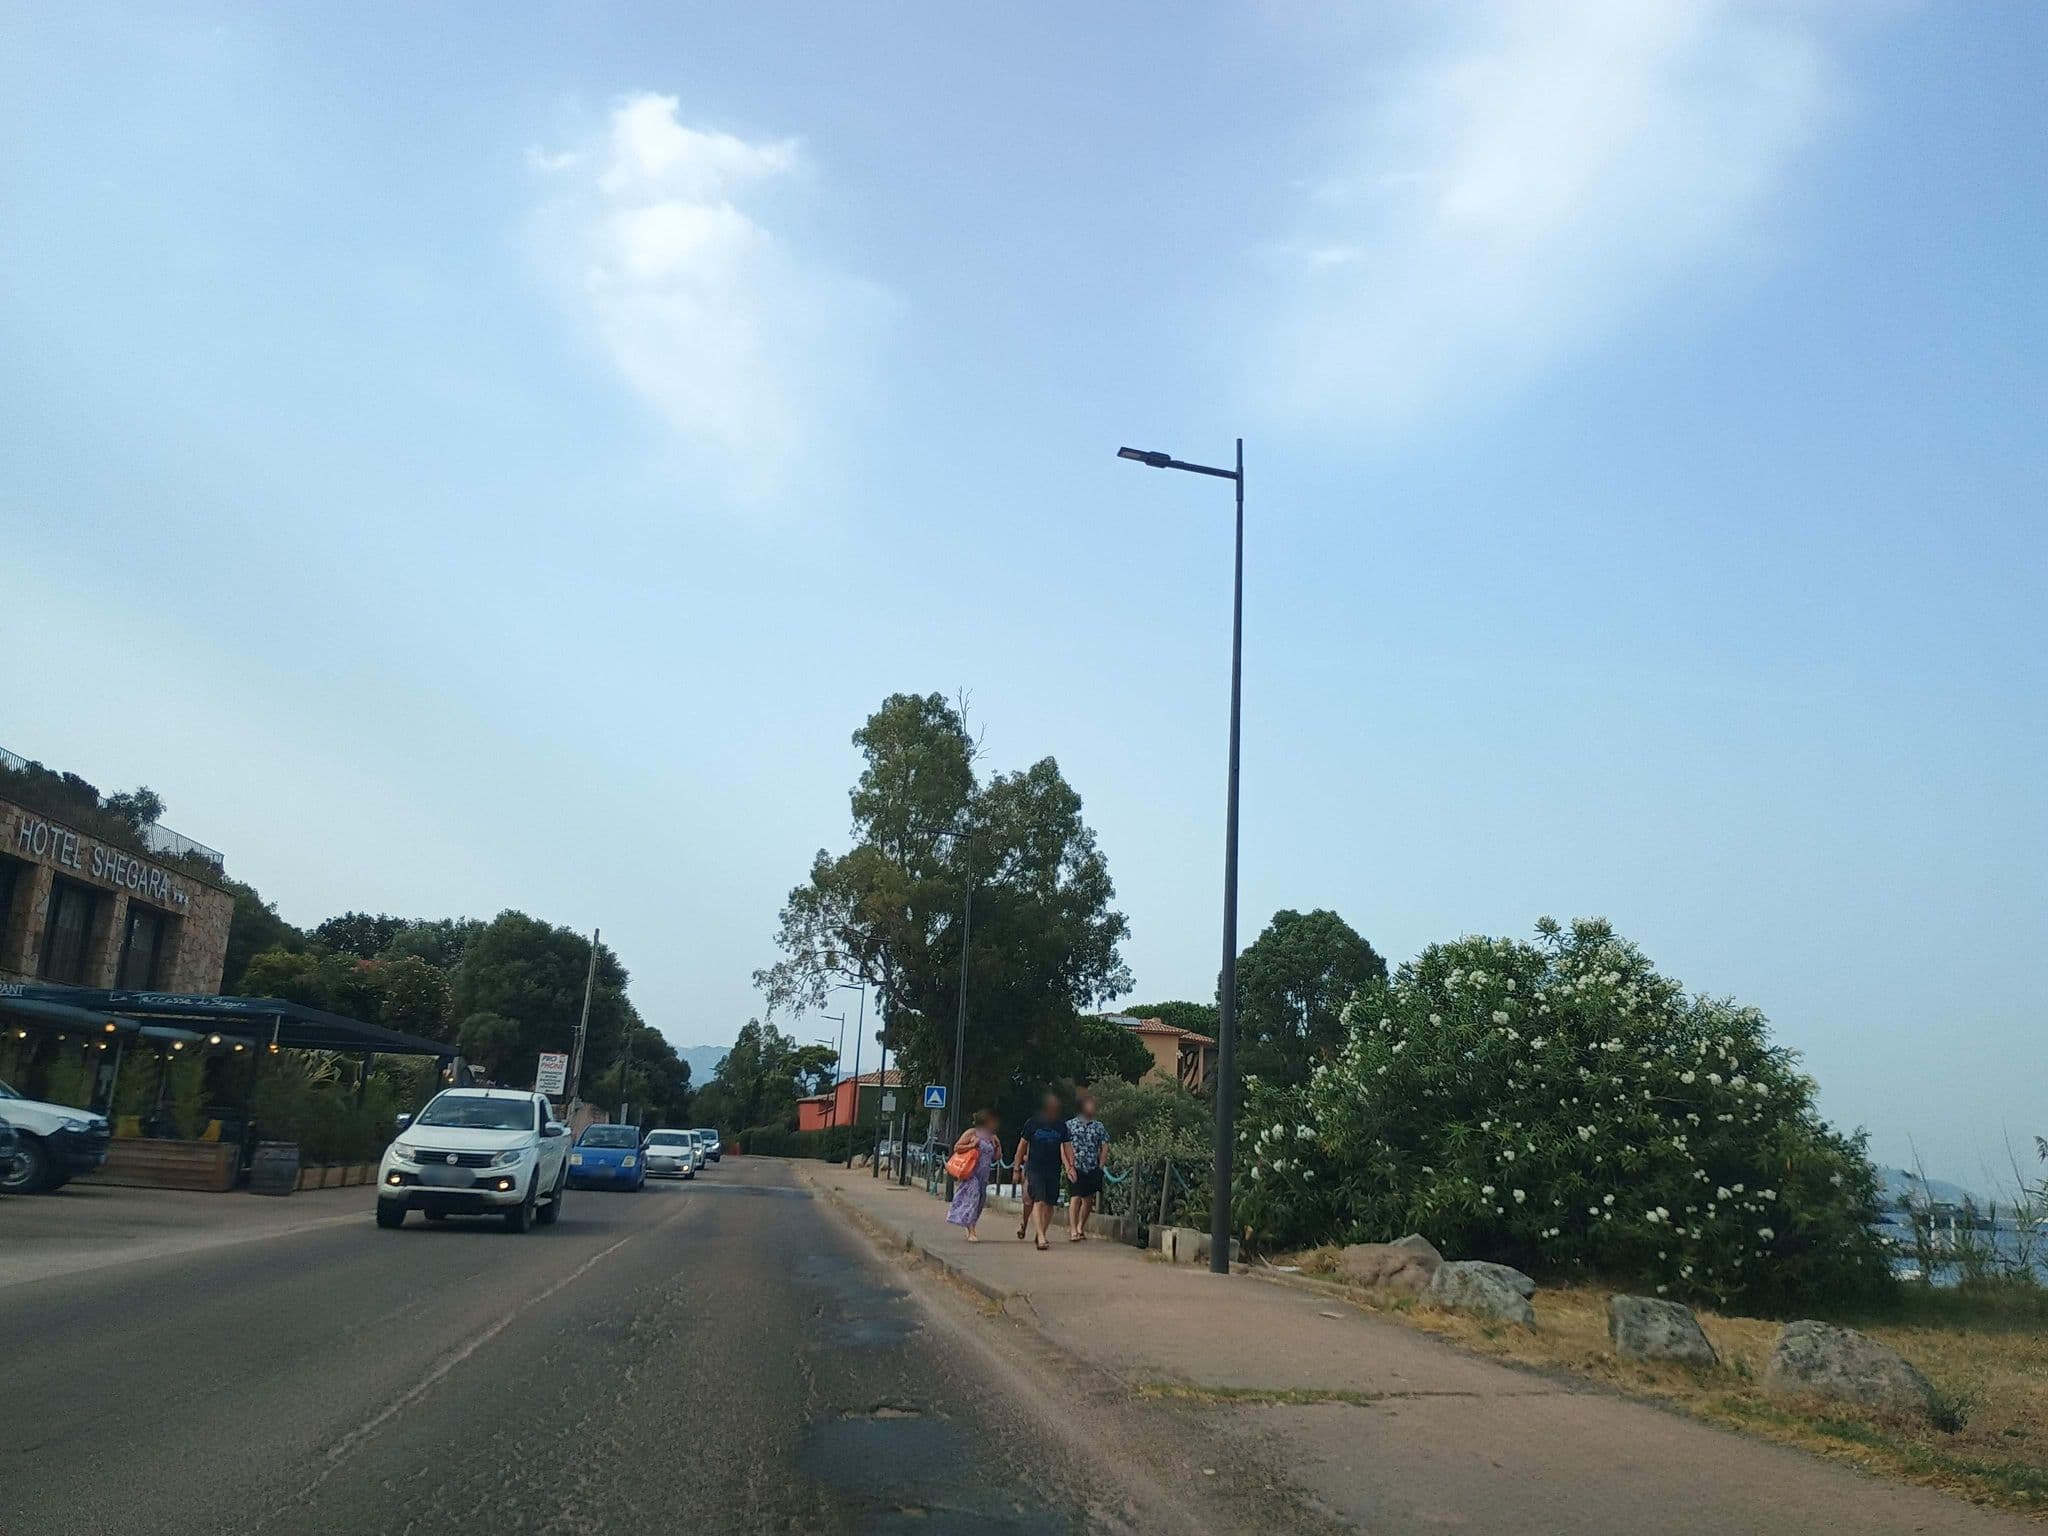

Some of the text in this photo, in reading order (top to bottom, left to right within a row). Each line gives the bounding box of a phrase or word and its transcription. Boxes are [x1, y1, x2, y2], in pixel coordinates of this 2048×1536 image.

[18, 815, 170, 898] HOTEL SHEGARA
[0, 984, 26, 993] ANT
[131, 992, 192, 1005] Terrasse
